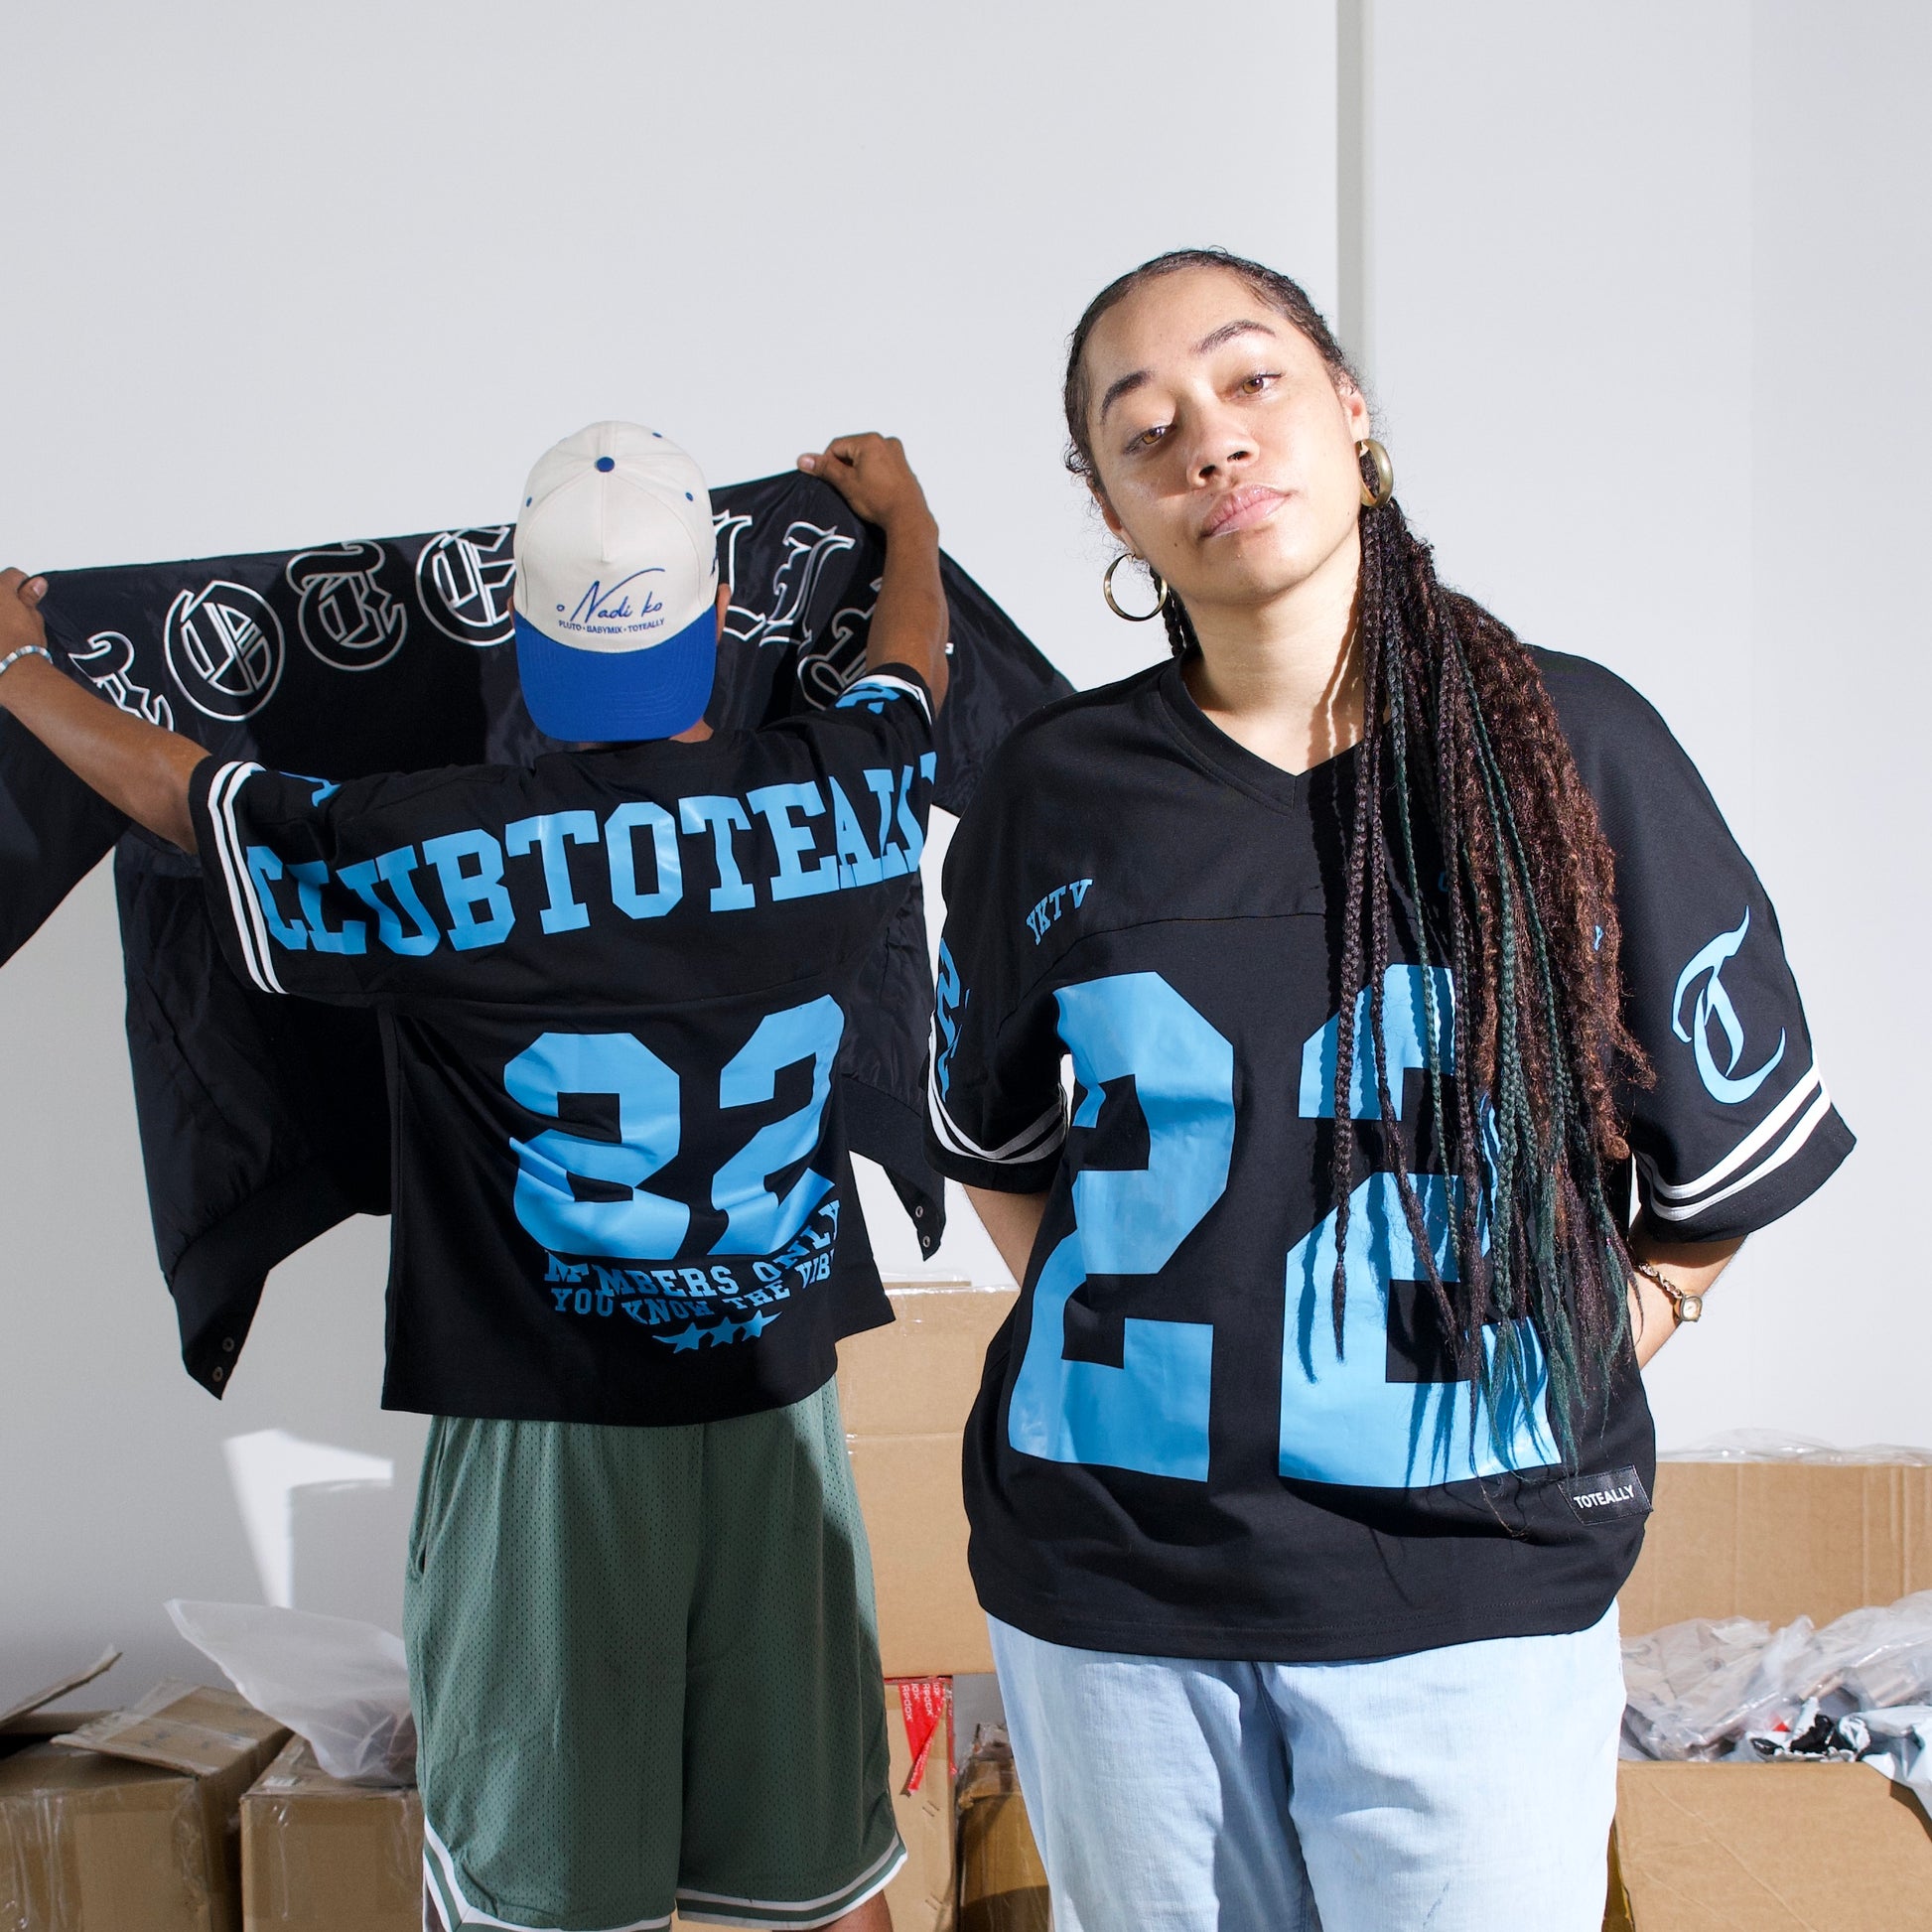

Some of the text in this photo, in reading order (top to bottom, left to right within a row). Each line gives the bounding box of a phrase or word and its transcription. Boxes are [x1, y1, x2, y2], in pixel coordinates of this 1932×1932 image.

[558, 618, 665, 634] PLUTO BABYMIX TOTEALLY
[1026, 879, 1093, 945] YKTV
[544, 1249, 740, 1298] MMBERS
[551, 1289, 614, 1317] YOU
[722, 1280, 790, 1311] THE
[794, 1248, 835, 1289] VIB
[1573, 1484, 1635, 1509] TOTEALLY
